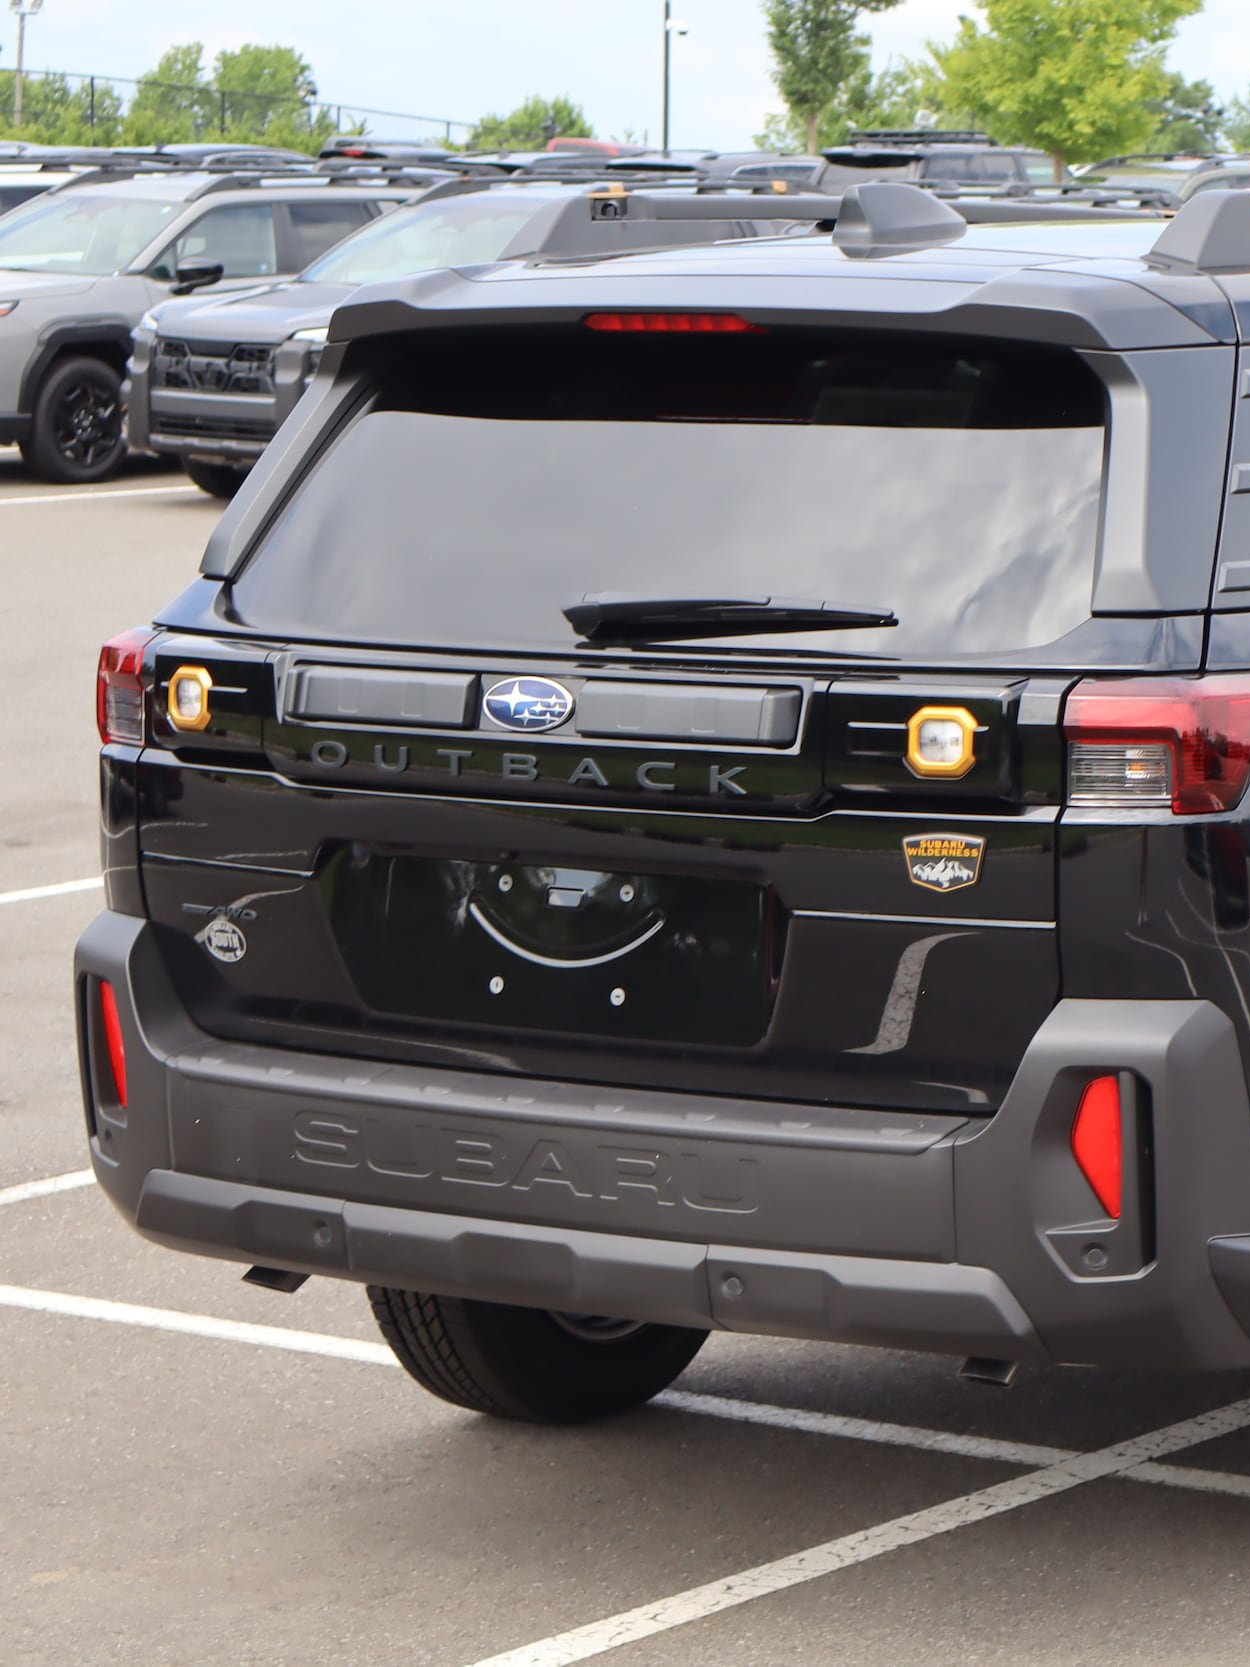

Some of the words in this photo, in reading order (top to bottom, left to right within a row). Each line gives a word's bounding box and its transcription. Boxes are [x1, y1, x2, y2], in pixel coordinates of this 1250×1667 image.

[310, 740, 748, 795] OUTBACK
[907, 847, 979, 857] WILDERNESS
[920, 839, 966, 849] SUBARU
[293, 1109, 760, 1214] SUBARU
